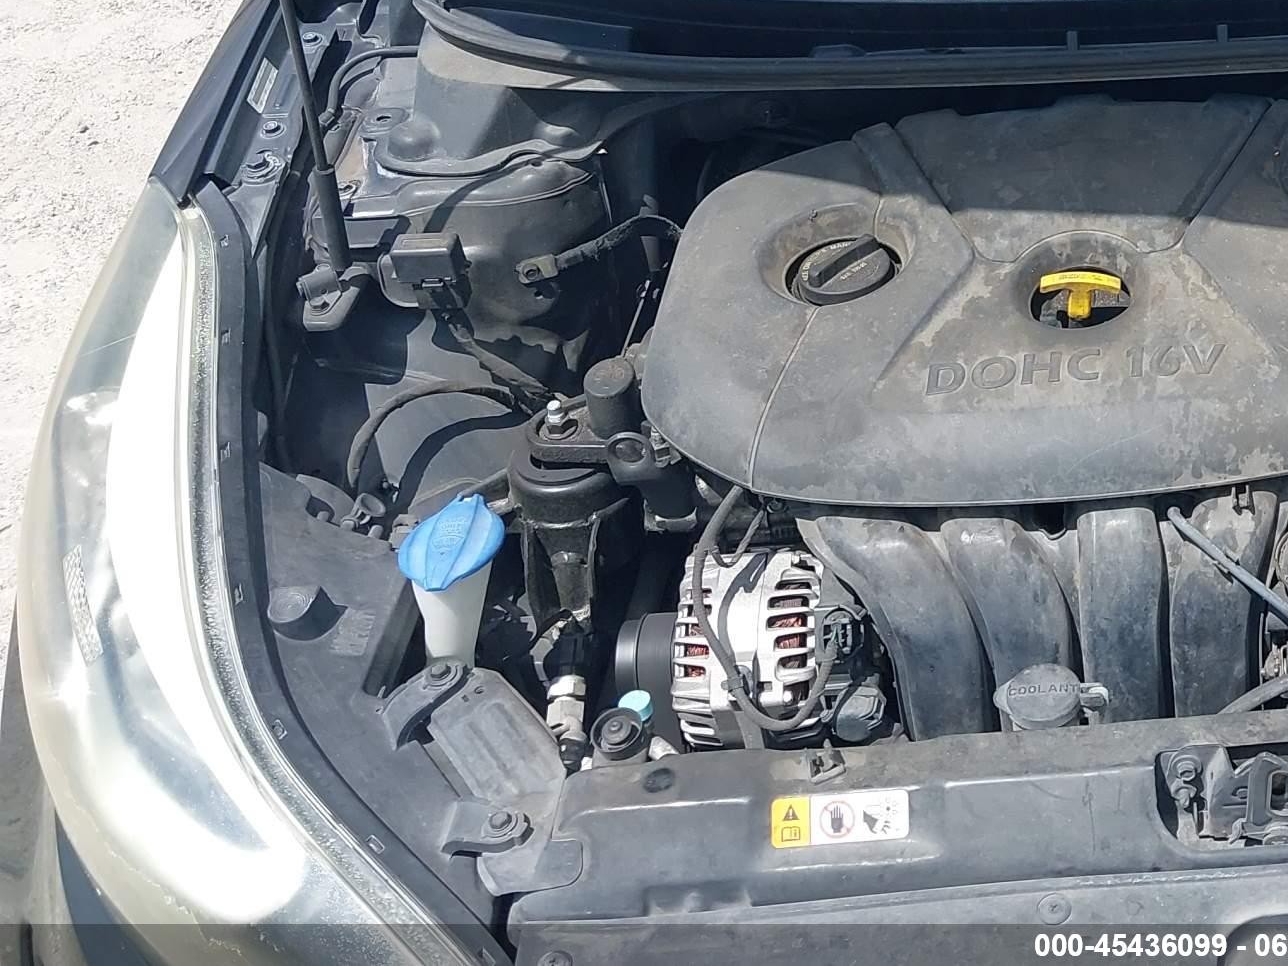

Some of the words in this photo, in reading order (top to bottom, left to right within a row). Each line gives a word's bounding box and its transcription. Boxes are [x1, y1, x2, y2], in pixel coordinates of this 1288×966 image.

[925, 348, 1101, 396] DOHC
[1125, 343, 1227, 378] 16V
[1008, 683, 1078, 696] COOLANT
